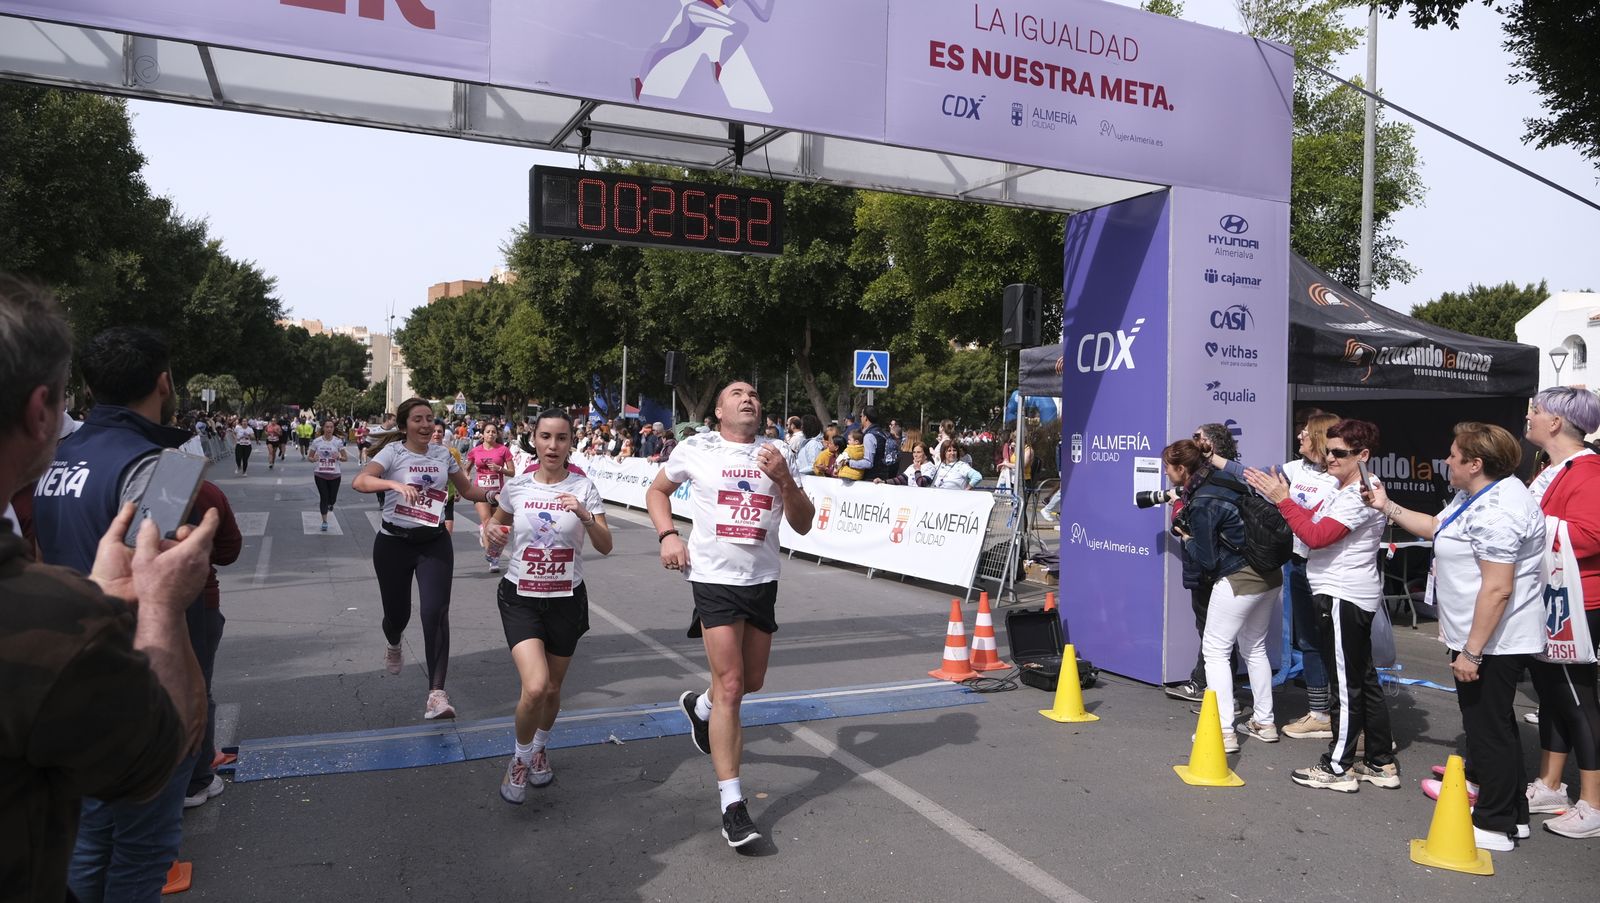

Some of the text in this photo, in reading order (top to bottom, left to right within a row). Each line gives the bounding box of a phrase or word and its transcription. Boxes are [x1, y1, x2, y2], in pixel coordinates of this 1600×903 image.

[975, 3, 1140, 62] LA IGUALDAD
[929, 40, 1175, 111] ES NUESTRA META.
[1032, 107, 1078, 126] ALMERÍA
[1031, 120, 1056, 131] CIUDAD
[577, 177, 772, 247] 00:25:52
[1208, 234, 1259, 250] HYUNDAI
[1215, 247, 1254, 260] Almerialva
[1221, 272, 1262, 286] cajamar
[1210, 309, 1246, 331] CASI
[1077, 318, 1145, 373] CDX
[1221, 345, 1258, 359] vithas
[1413, 368, 1457, 379] cronometraje
[1212, 388, 1256, 405] aqualia
[1091, 432, 1151, 450] ALMERÍA
[1091, 452, 1120, 462] CIUDAD
[722, 469, 762, 479] MUJER
[1294, 483, 1318, 494] MUJER
[524, 501, 564, 511] MUJER
[729, 506, 761, 522] 702
[839, 501, 890, 525] ALMERÍA
[836, 521, 863, 535] CIUDAD
[917, 510, 979, 535] ALMERÍA
[915, 531, 946, 547] CIUDAD
[526, 562, 566, 575] 2544
